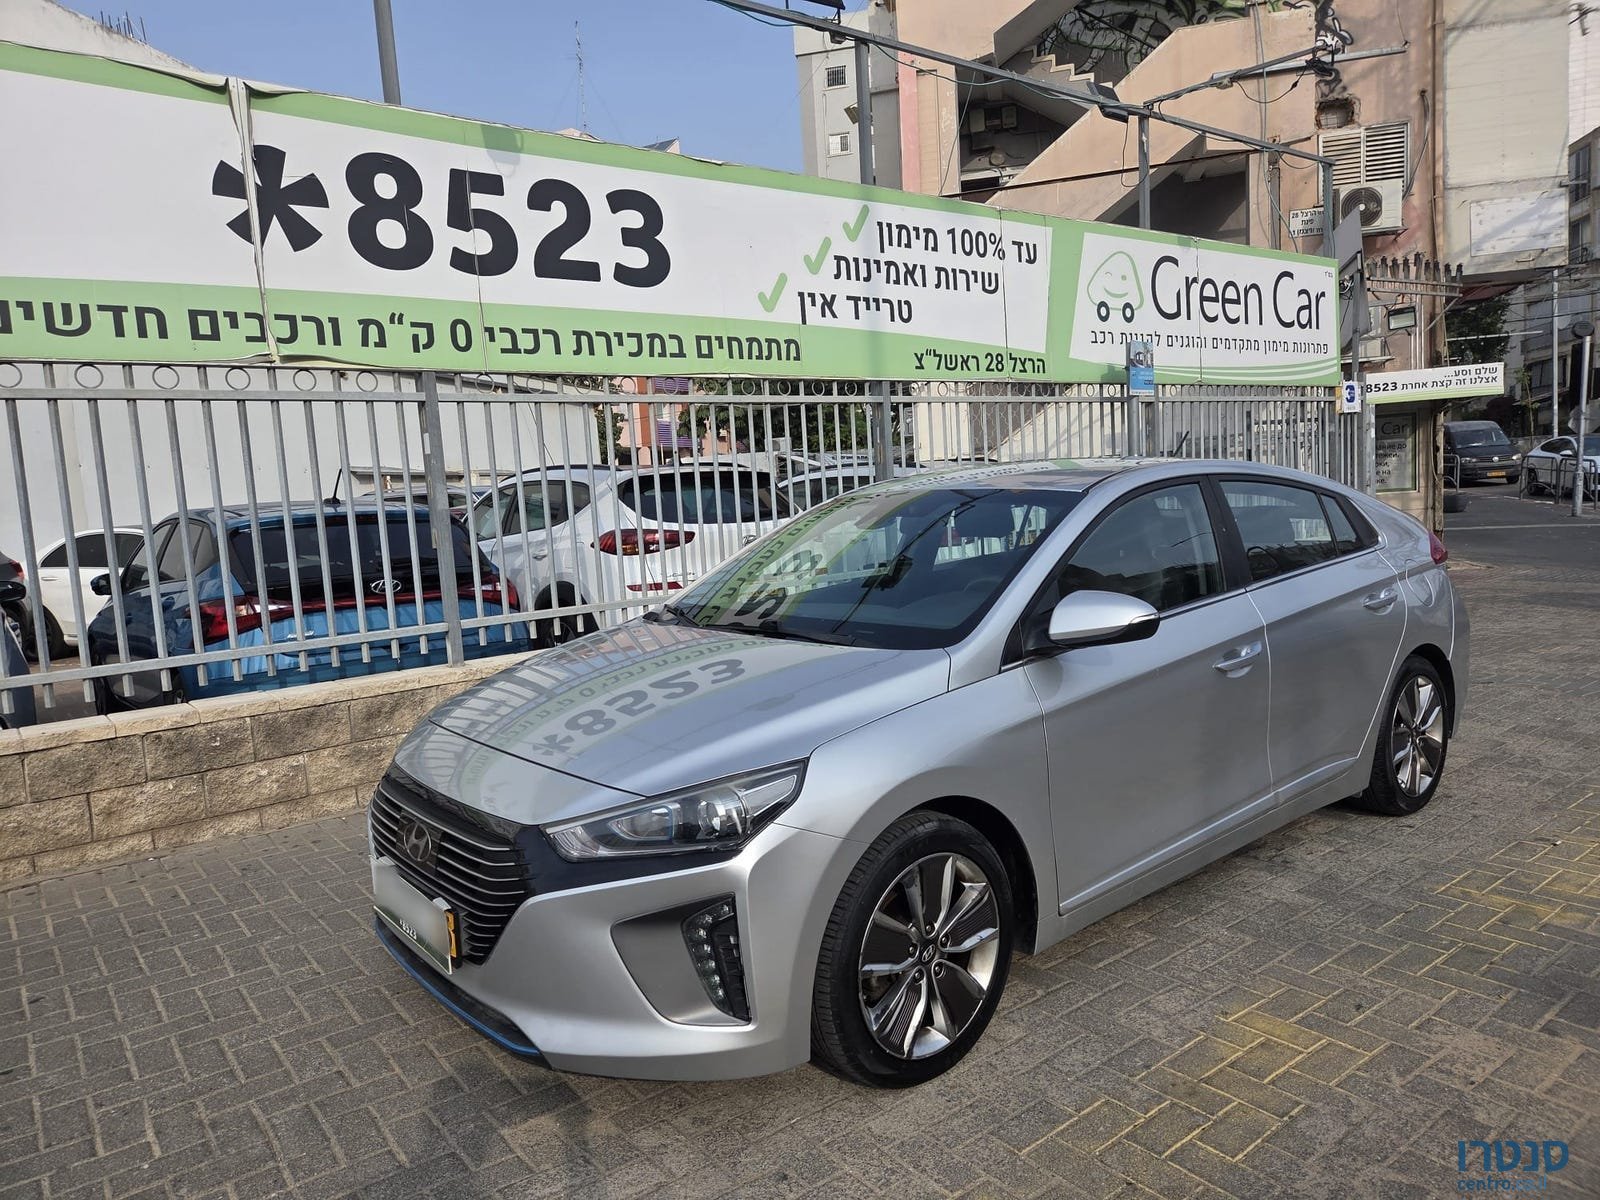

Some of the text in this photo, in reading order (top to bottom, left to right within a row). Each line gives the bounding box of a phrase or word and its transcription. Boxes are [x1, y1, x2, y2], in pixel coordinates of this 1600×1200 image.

[876, 220, 1038, 265] עד 100% מימון
[833, 254, 999, 295] שירות ואמינות
[1151, 255, 1326, 330] Green Car
[797, 291, 913, 326] טרייד אין
[187, 308, 342, 348] ורכבים
[450, 318, 473, 353] 0
[1090, 330, 1115, 345] רכב
[484, 326, 562, 356] רכבי
[572, 329, 687, 359] במכירת
[695, 334, 801, 361] מתמחים
[1166, 335, 1207, 350] והוגנים
[1211, 337, 1260, 355] מתקדמים
[1263, 340, 1289, 355] מימון
[1292, 341, 1329, 355] פתרונות
[984, 352, 1005, 373] 28
[1009, 352, 1046, 374] הרצל
[1474, 366, 1498, 375] שלם
[1401, 381, 1429, 391] אחרת
[1431, 379, 1452, 388] קצת
[1455, 378, 1467, 386] זה
[1469, 376, 1498, 385] אצלנו
[1381, 421, 1410, 435] Car
